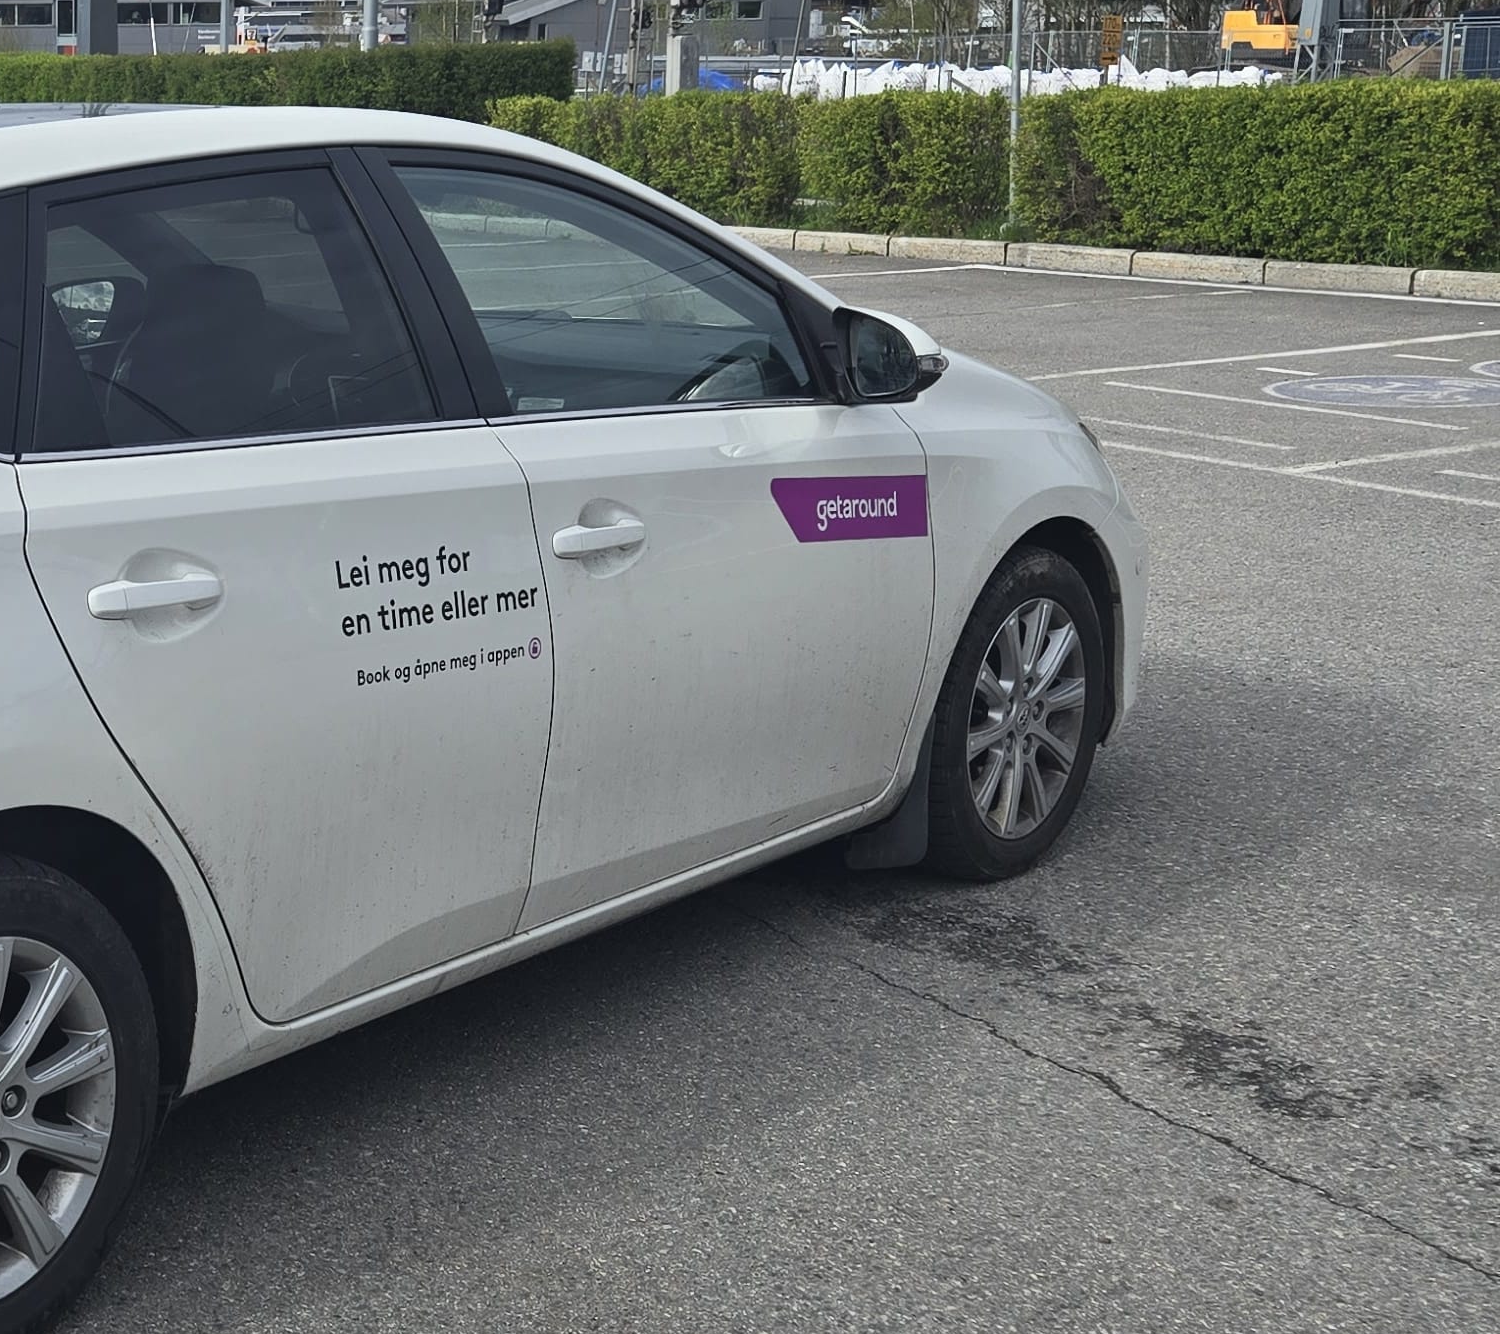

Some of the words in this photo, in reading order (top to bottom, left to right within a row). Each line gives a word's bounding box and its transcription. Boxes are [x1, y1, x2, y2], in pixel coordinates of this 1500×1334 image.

[817, 491, 898, 531] getaround
[335, 555, 370, 589] Lei
[378, 556, 430, 587] meg
[436, 546, 470, 574] for
[341, 613, 371, 637] en
[377, 599, 434, 630] time
[441, 590, 489, 621] eller
[496, 587, 538, 612] mer
[357, 667, 390, 686] Book
[394, 668, 411, 682] og
[414, 658, 446, 680] åpne
[450, 653, 477, 671] meg
[480, 648, 484, 663] i
[487, 645, 525, 666] appen
